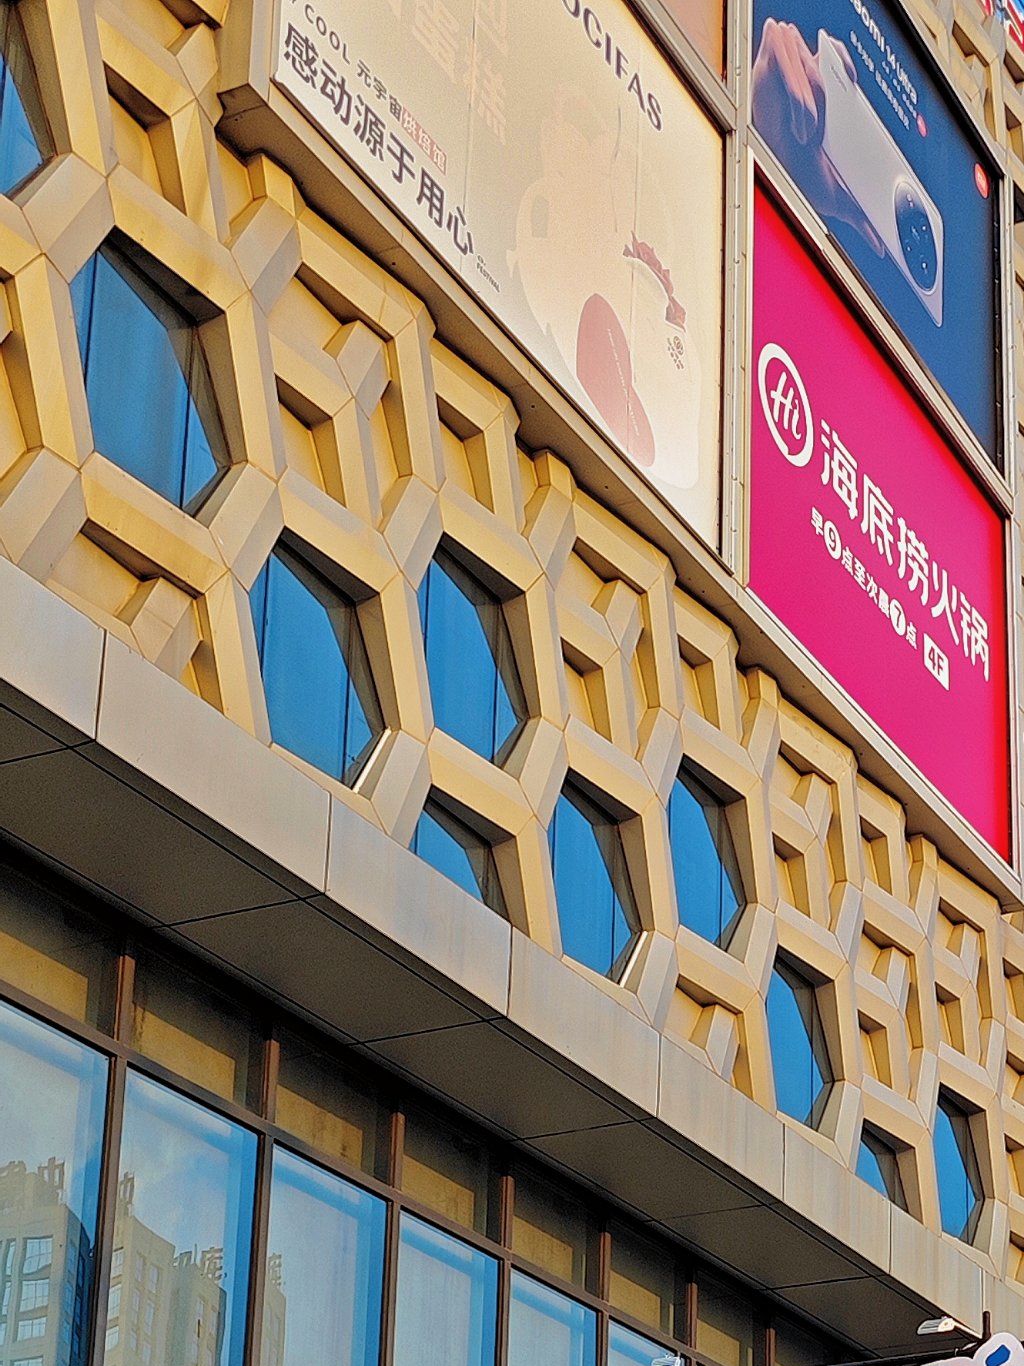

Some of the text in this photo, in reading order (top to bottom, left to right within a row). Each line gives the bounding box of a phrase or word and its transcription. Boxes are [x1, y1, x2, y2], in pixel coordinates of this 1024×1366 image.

[303, 3, 352, 66] COOL
[896, 62, 918, 105] Ultra
[283, 21, 475, 257] 感动源于用心
[769, 371, 803, 441] Hi
[820, 418, 990, 683] 海底捞火锅
[927, 645, 945, 678] 4F
